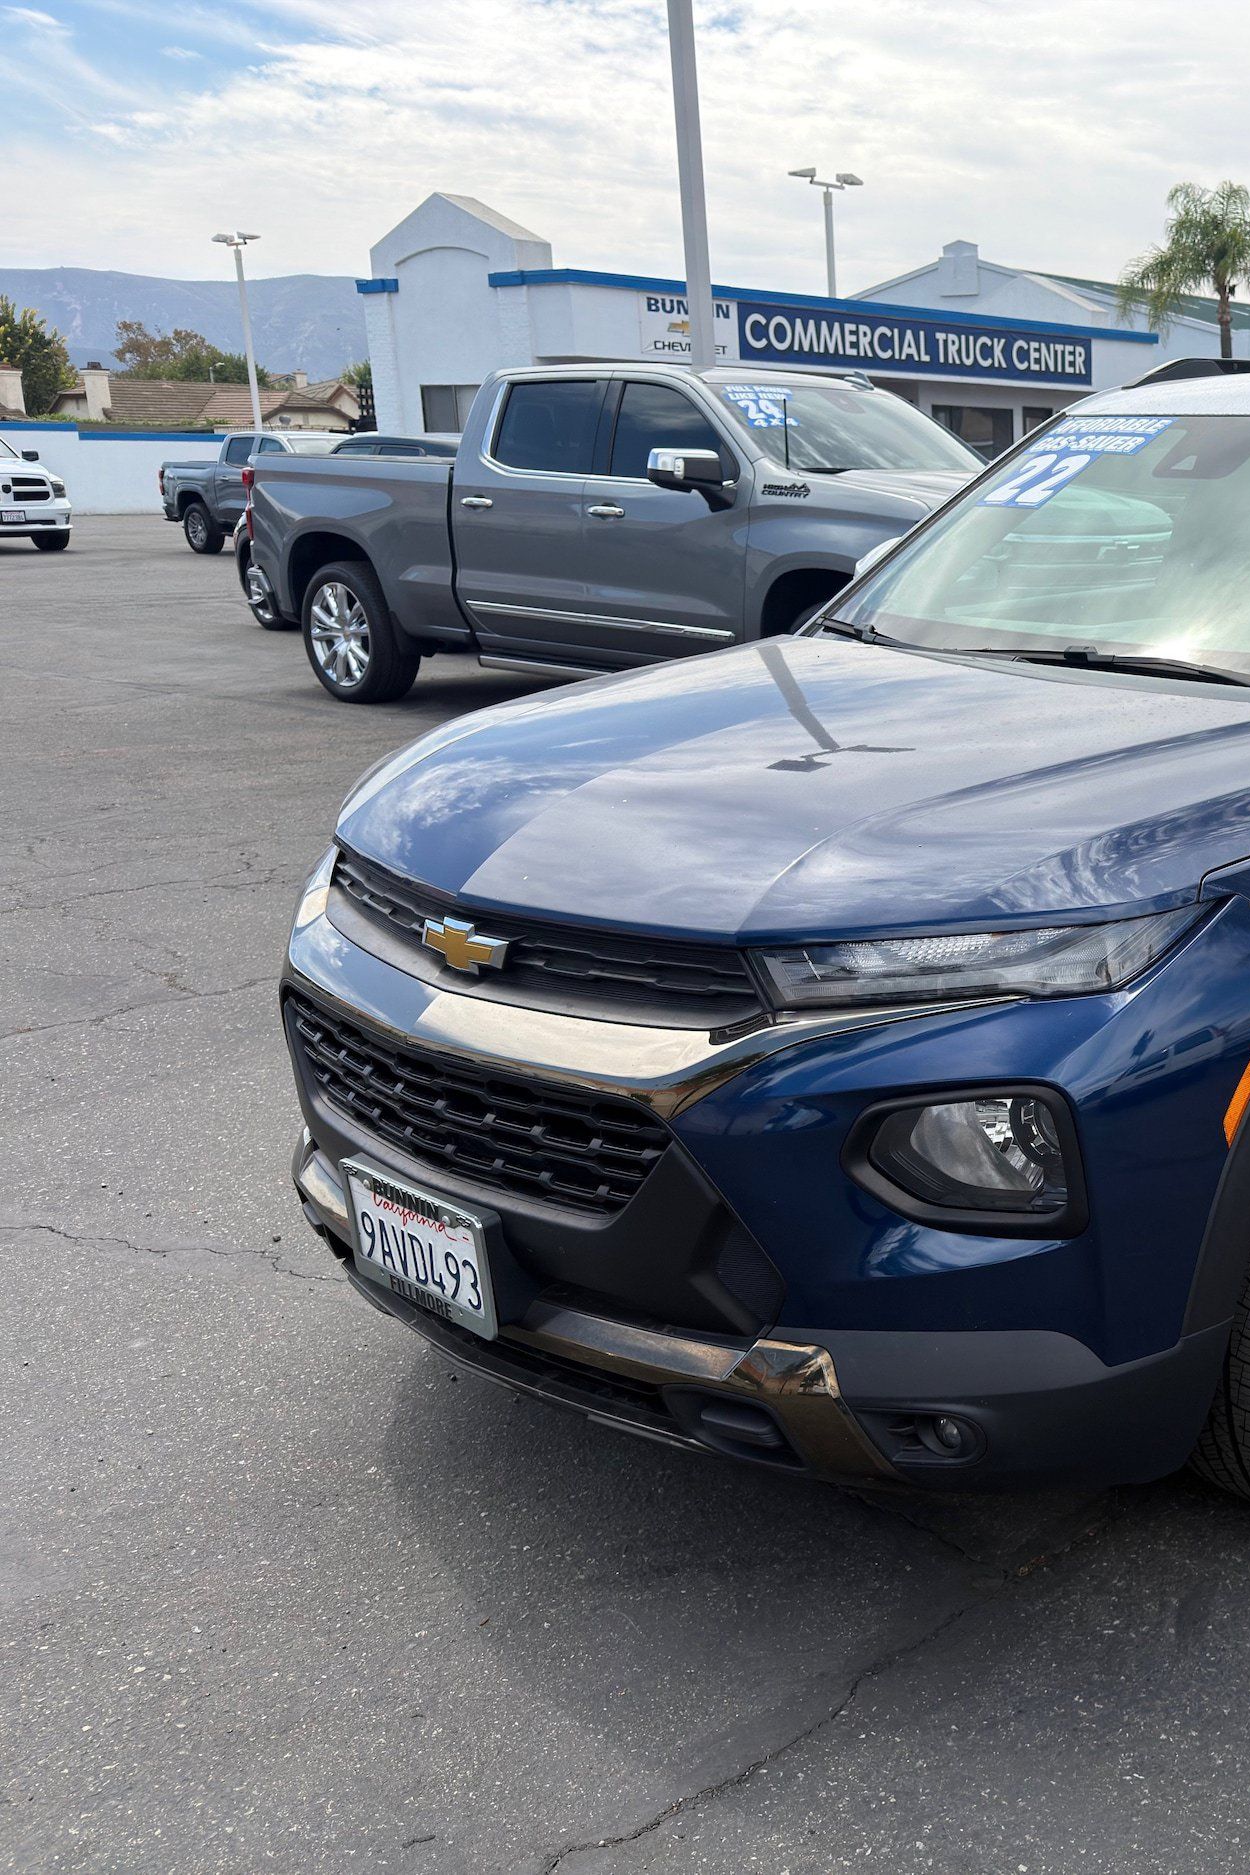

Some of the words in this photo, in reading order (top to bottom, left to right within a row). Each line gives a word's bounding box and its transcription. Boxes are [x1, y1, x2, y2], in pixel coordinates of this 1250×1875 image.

[646, 296, 730, 319] BUNN
[745, 313, 931, 362] COMMERCIAL
[935, 332, 1007, 368] TRUCK
[1012, 339, 1085, 374] CENTER
[728, 392, 758, 400] LIKE
[1050, 418, 1173, 434] AFFORDABLE
[1030, 435, 1146, 452] GAS-SAVER
[761, 489, 809, 498] COUNTRY
[984, 453, 1091, 505] 22
[372, 1175, 439, 1222] BUNNIN
[361, 1211, 482, 1311] 9AVD493
[389, 1274, 453, 1319] FILLMORE
